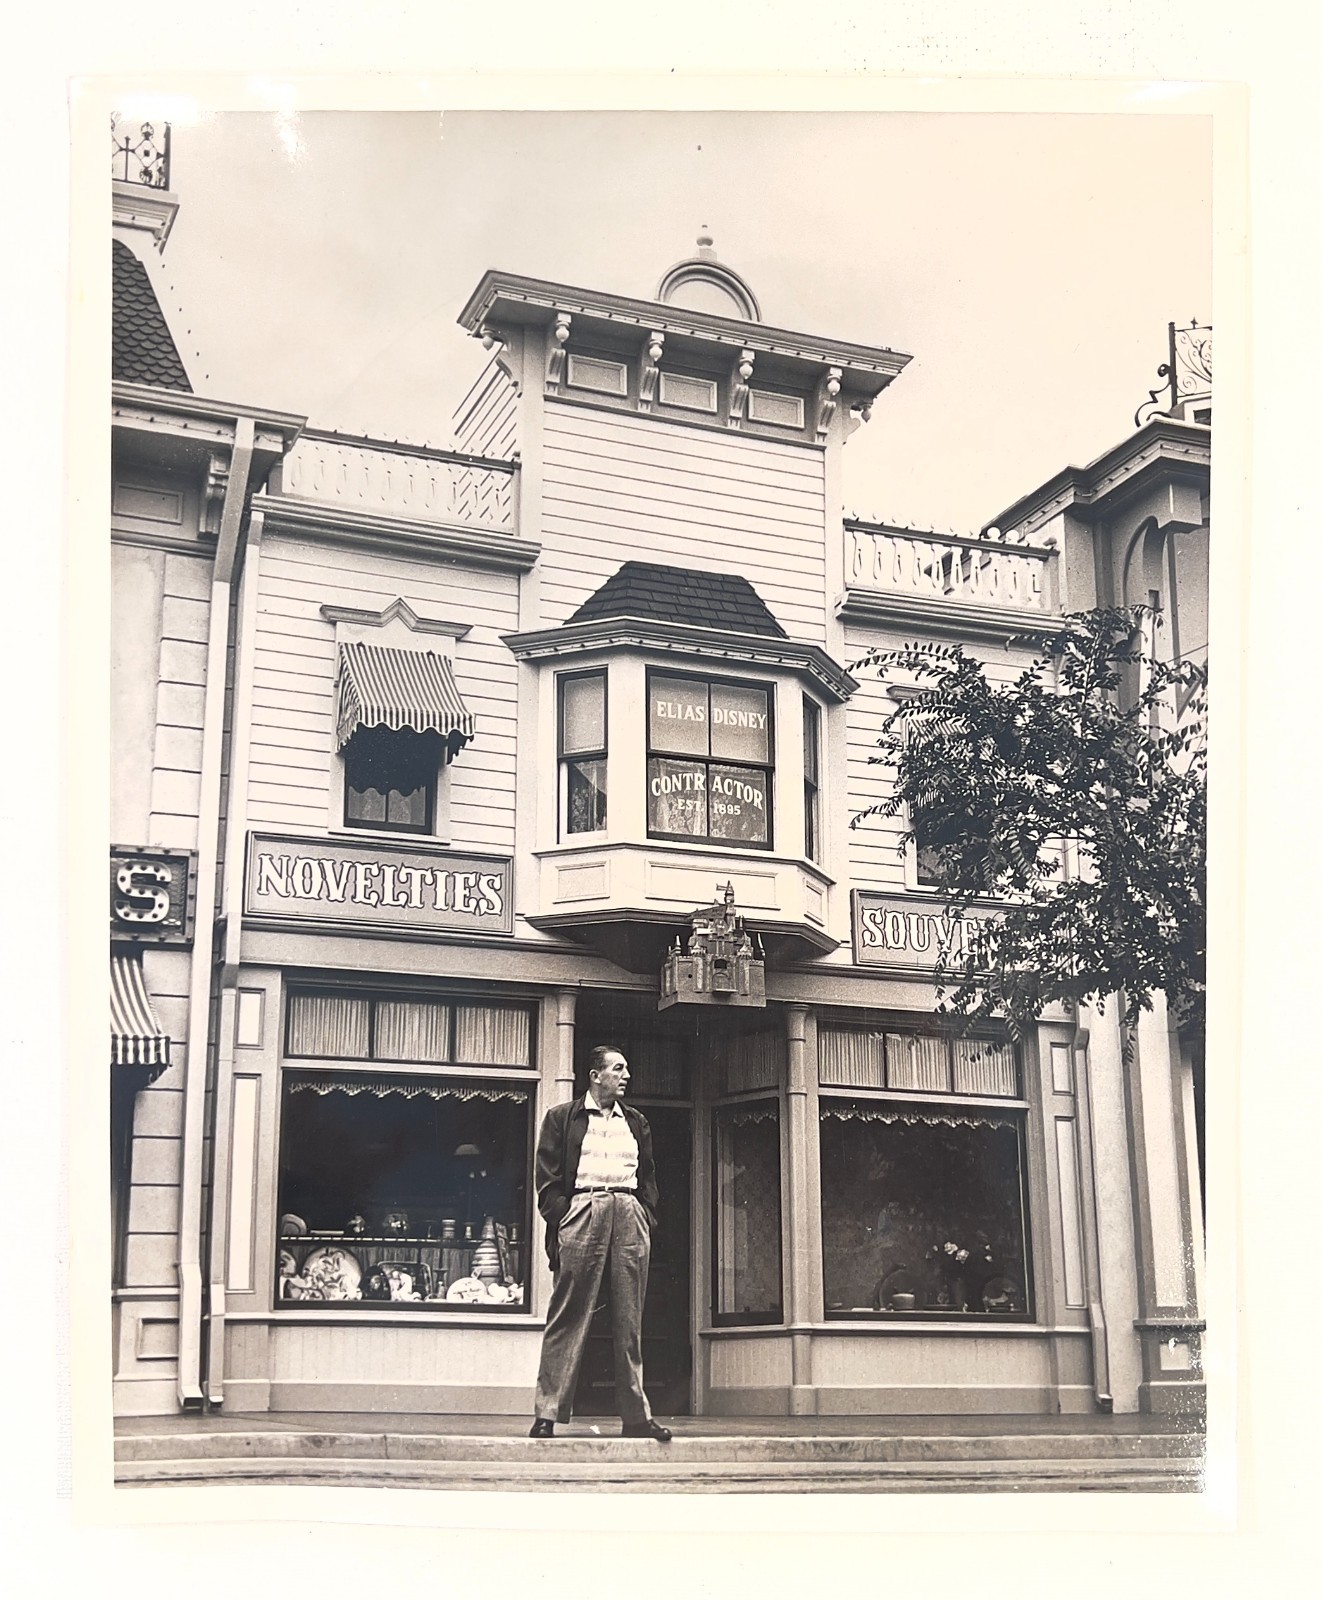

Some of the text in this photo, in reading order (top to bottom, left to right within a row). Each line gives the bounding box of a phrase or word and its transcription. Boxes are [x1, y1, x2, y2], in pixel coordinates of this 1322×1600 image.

[656, 700, 767, 730] ELIAS DISNEY
[713, 803, 741, 815] 1895
[257, 853, 503, 917] NOVELTIES
